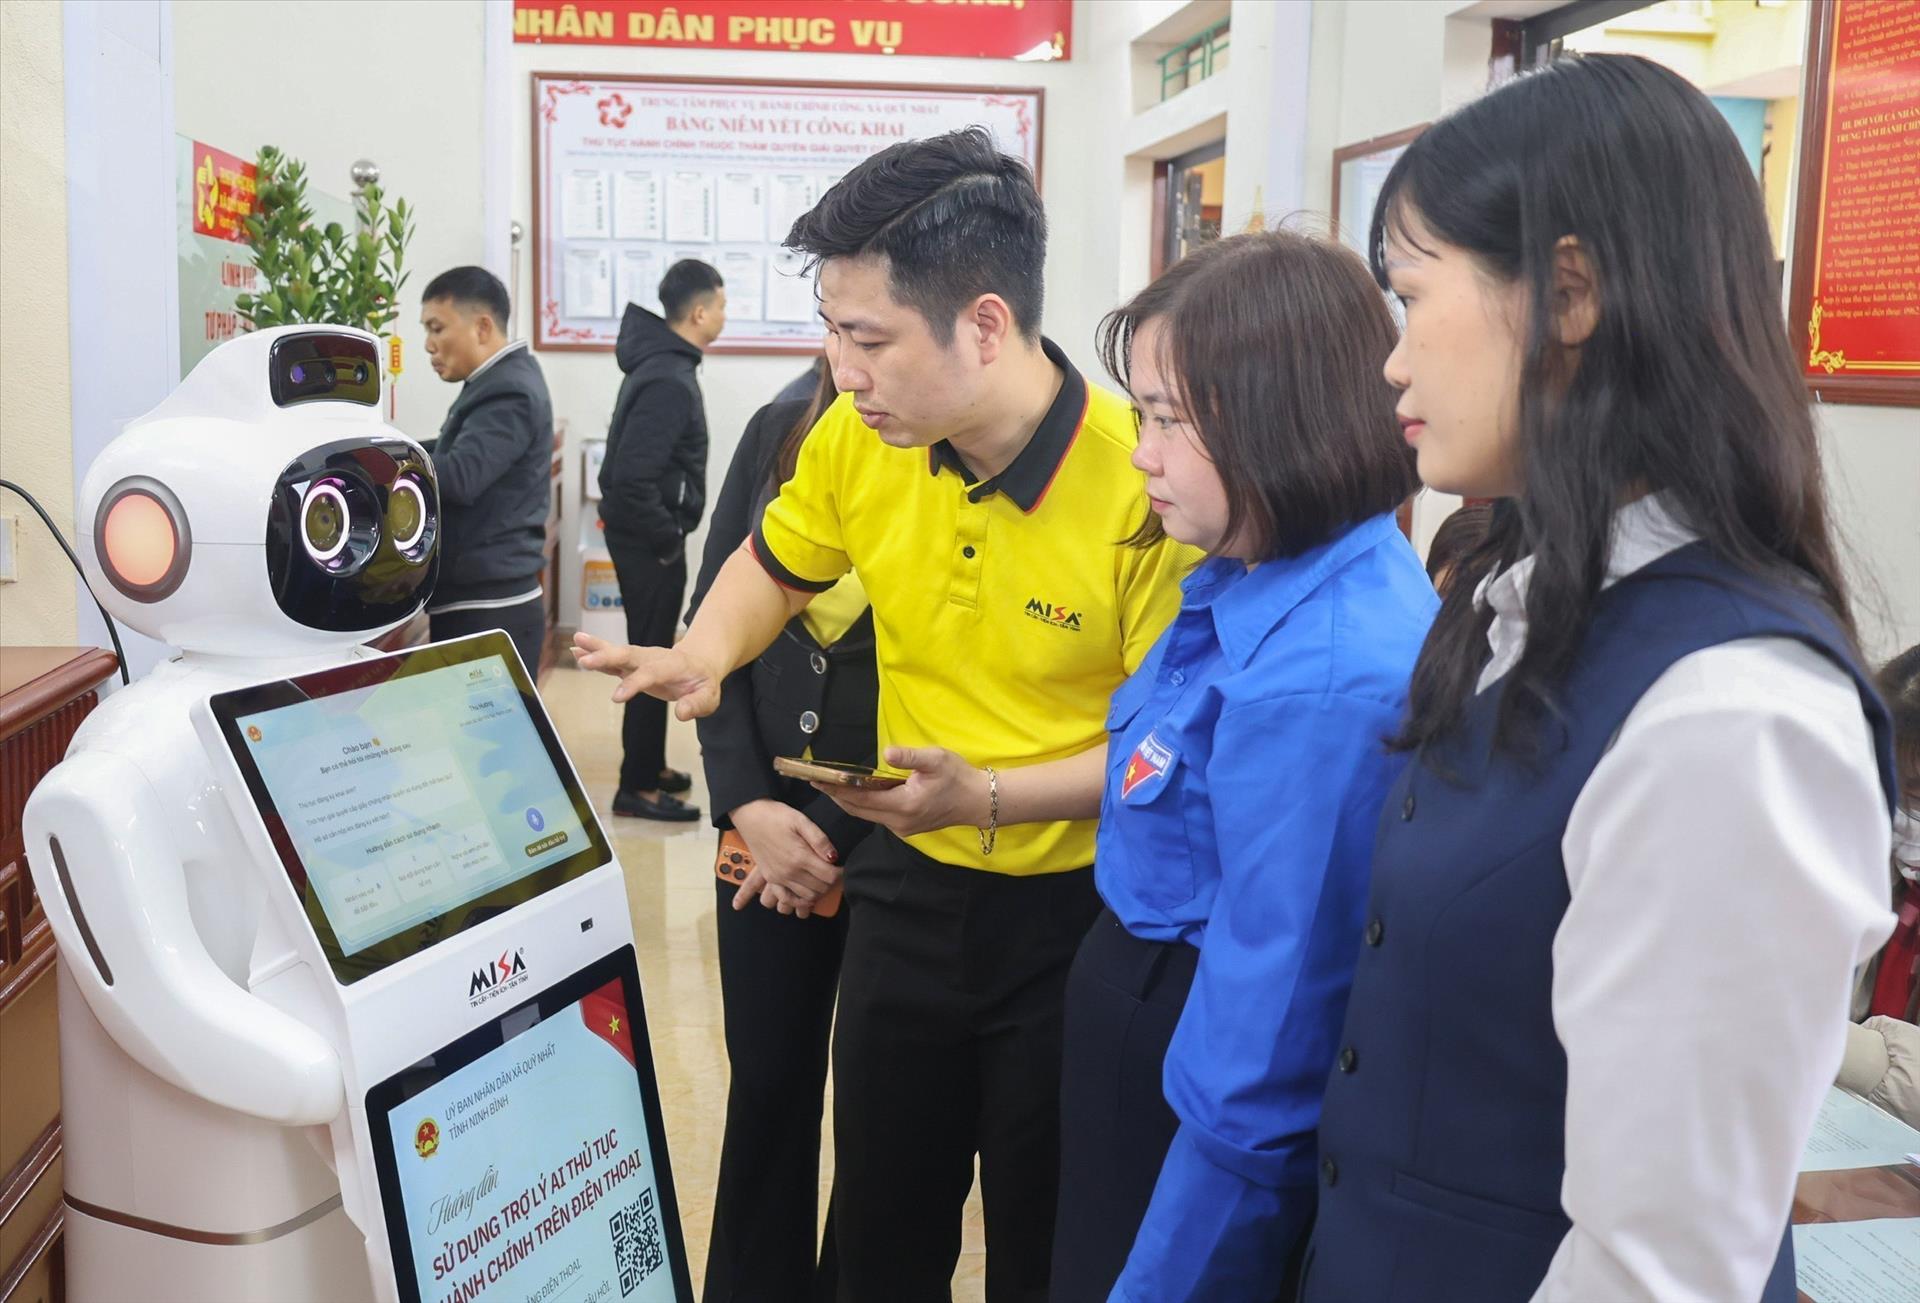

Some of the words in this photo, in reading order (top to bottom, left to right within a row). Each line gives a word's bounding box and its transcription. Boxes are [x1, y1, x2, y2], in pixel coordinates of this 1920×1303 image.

[513, 3, 614, 39] NHÂN
[627, 7, 715, 42] DÂN
[728, 15, 836, 50] PHỤC
[849, 20, 904, 55] VỤ
[861, 121, 904, 136] KHAI
[1025, 597, 1080, 626] MISA
[469, 949, 526, 997] MISA
[457, 1095, 474, 1114] BAN
[474, 1081, 497, 1104] NHÂN
[496, 1071, 512, 1090] DÂN
[512, 1062, 522, 1080] XÃ
[448, 1123, 469, 1141] TỈNH
[469, 1107, 489, 1129] NINH
[489, 1094, 509, 1116] BÌNH
[427, 1187, 476, 1236] Hướng
[433, 1241, 455, 1281] SỬ
[457, 1215, 501, 1264] DỤNG
[501, 1189, 531, 1230] TRỢ
[531, 1173, 547, 1207] LÝ
[551, 1166, 566, 1195] AI
[565, 1140, 593, 1180] THỦ
[593, 1128, 618, 1160] TỤC
[487, 1231, 535, 1283] CHÍNH
[534, 1204, 571, 1245] TRÊN
[571, 1179, 604, 1218] ĐIỆN
[602, 1148, 642, 1192] THOẠI
